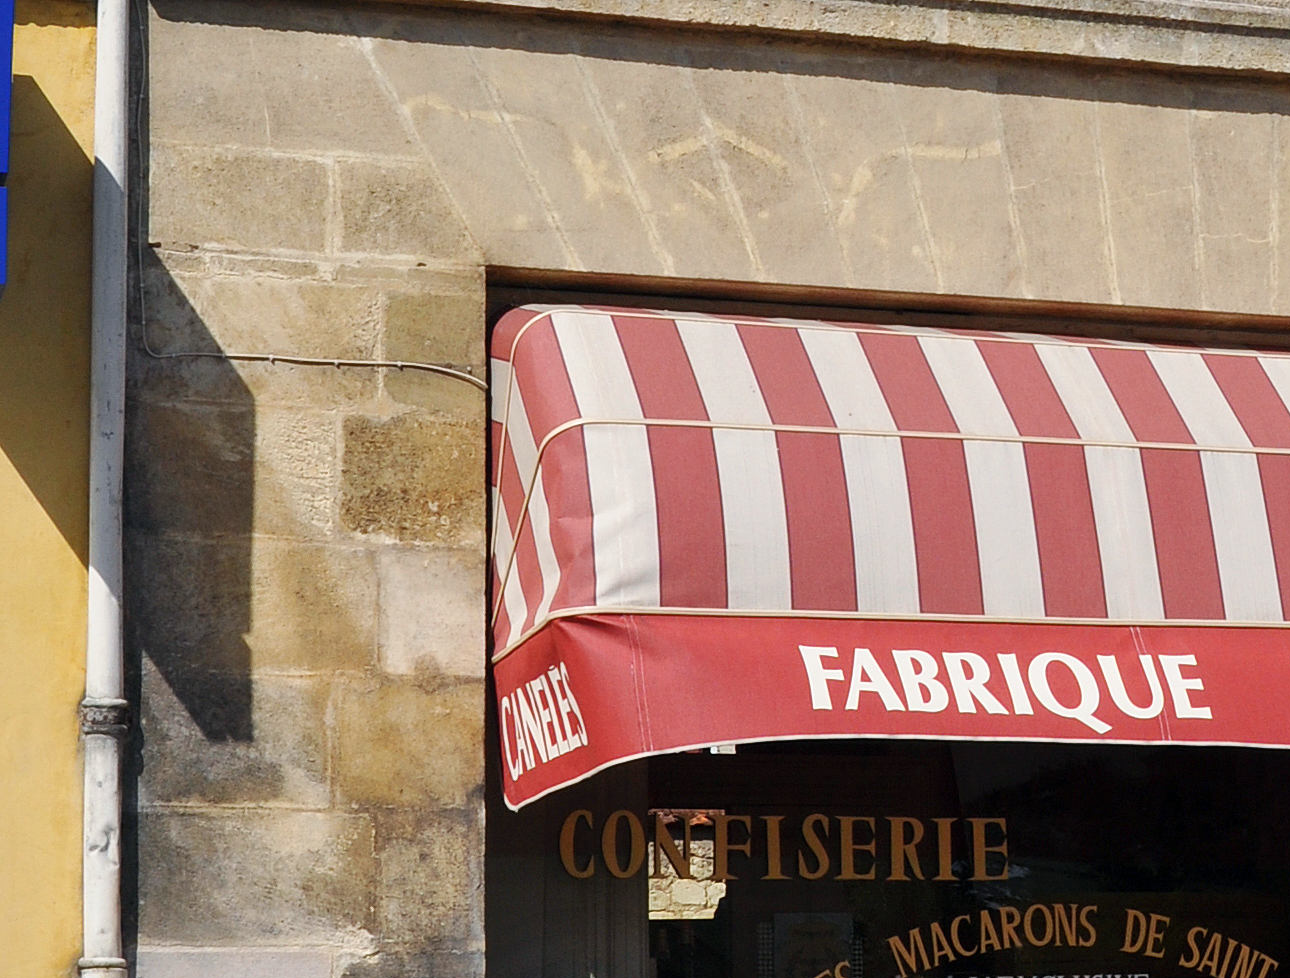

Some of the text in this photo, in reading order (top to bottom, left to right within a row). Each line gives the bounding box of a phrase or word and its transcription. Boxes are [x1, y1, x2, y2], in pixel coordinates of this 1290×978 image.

[799, 644, 1213, 734] FABRIQUE
[558, 808, 1010, 883] CONFISERIE
[1122, 908, 1168, 959] DE
